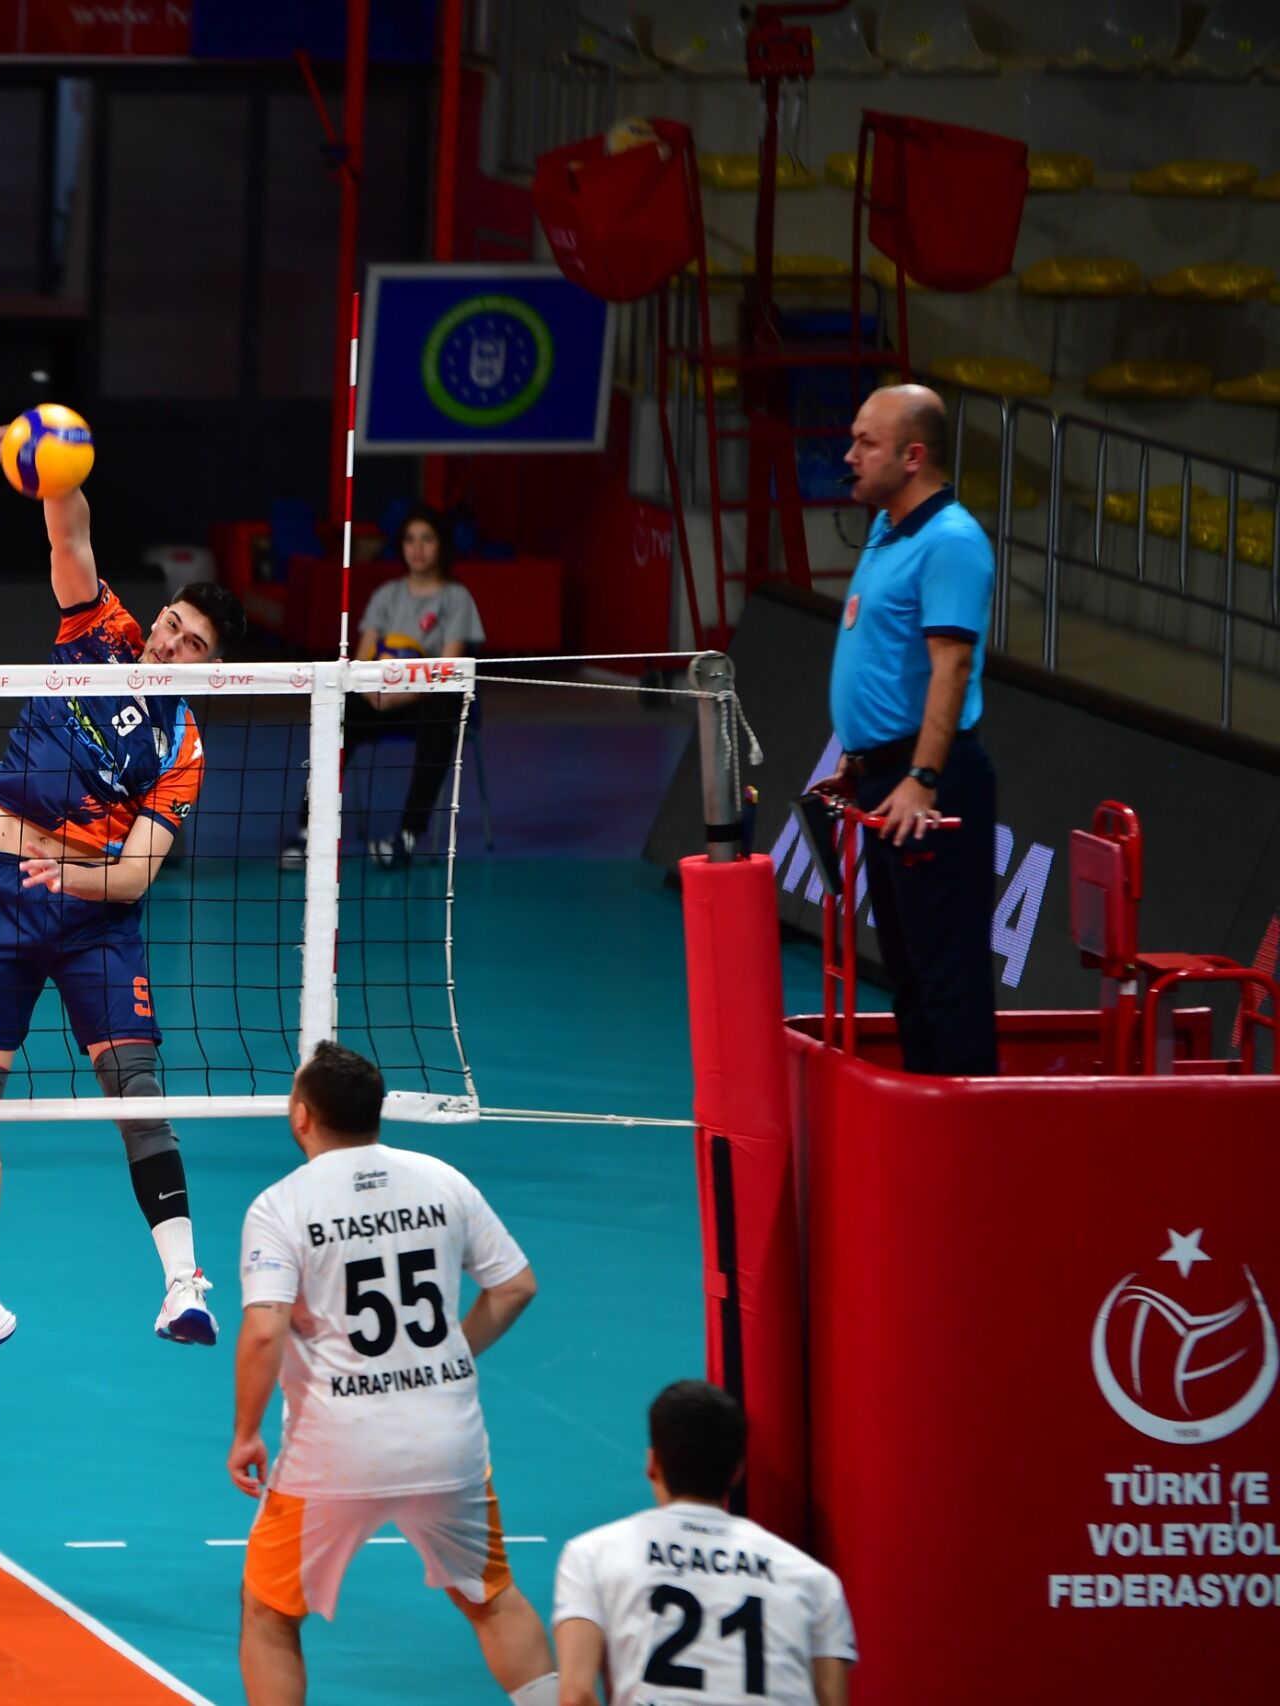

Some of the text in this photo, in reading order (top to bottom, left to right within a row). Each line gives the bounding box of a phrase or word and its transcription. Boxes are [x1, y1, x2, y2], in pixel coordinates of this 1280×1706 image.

[66, 675, 91, 687] TVF
[147, 675, 172, 686] TVF
[229, 674, 254, 685] TVF
[406, 663, 455, 684] TVF
[112, 706, 143, 737] 9
[308, 1204, 447, 1247] B.TAŞKIRAN
[345, 1248, 448, 1357] 55
[331, 1366, 438, 1398] KARAPINAR
[1087, 1523, 1280, 1557] VOLEYBOL
[648, 1541, 775, 1584] AÇACAK
[1048, 1573, 1280, 1608] FEDERASYO
[642, 1584, 766, 1696] 21
